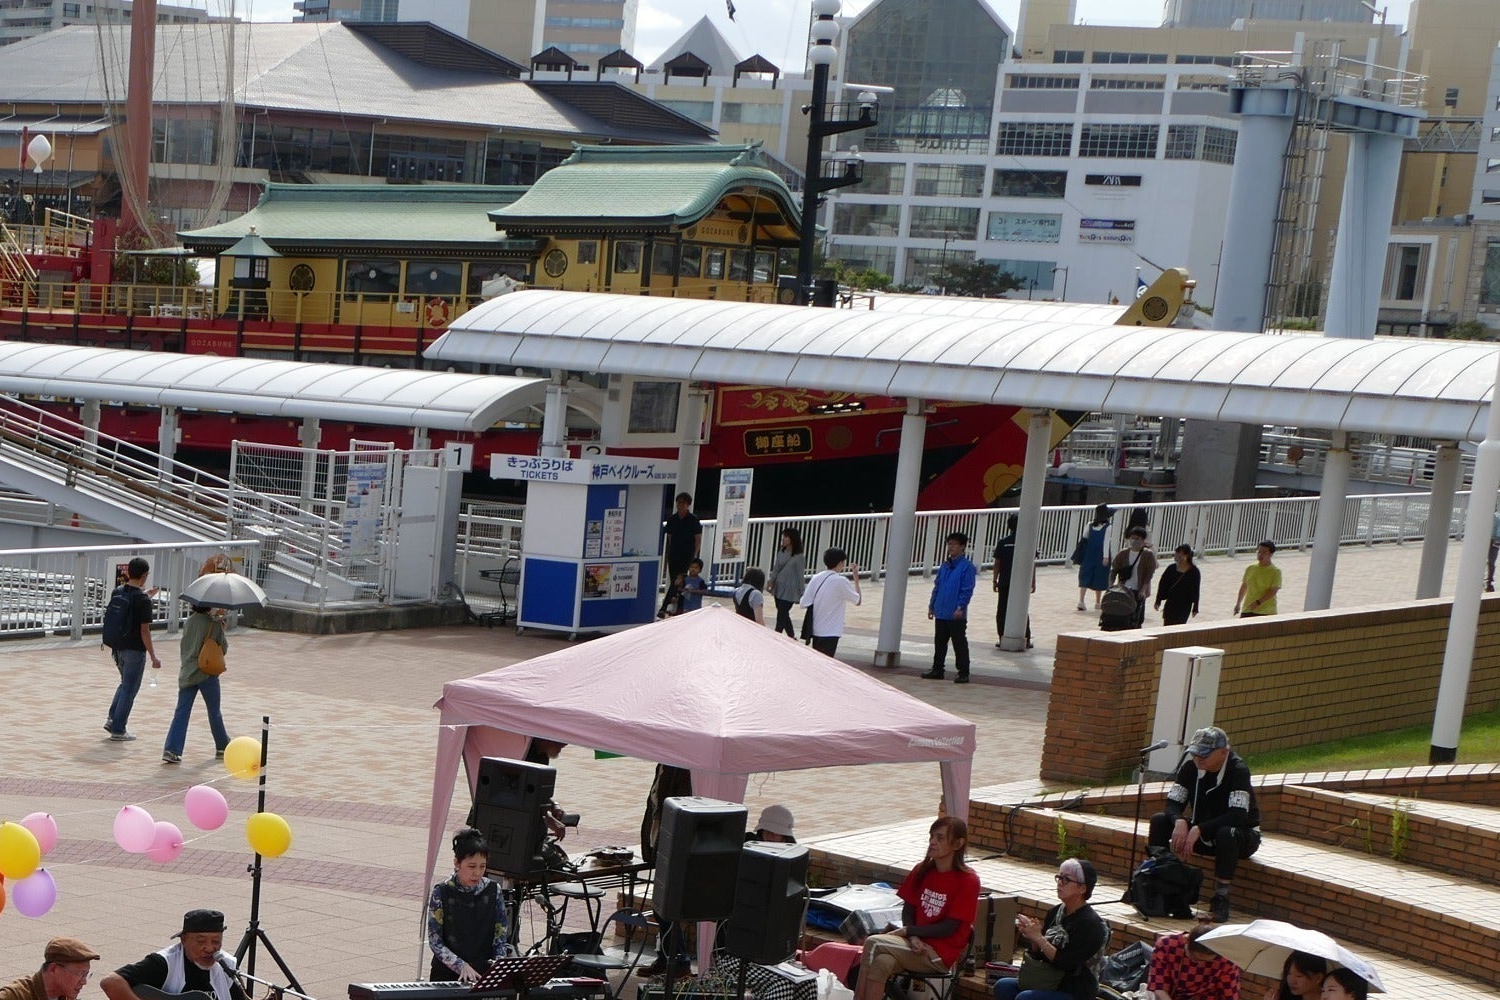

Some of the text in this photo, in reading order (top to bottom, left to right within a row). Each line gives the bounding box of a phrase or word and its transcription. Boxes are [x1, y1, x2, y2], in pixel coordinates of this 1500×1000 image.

[453, 447, 462, 466] 1
[506, 456, 574, 472] きっぷうりば
[520, 470, 559, 481] TICKETS
[592, 463, 655, 481] 神戸ベイクルーズ
